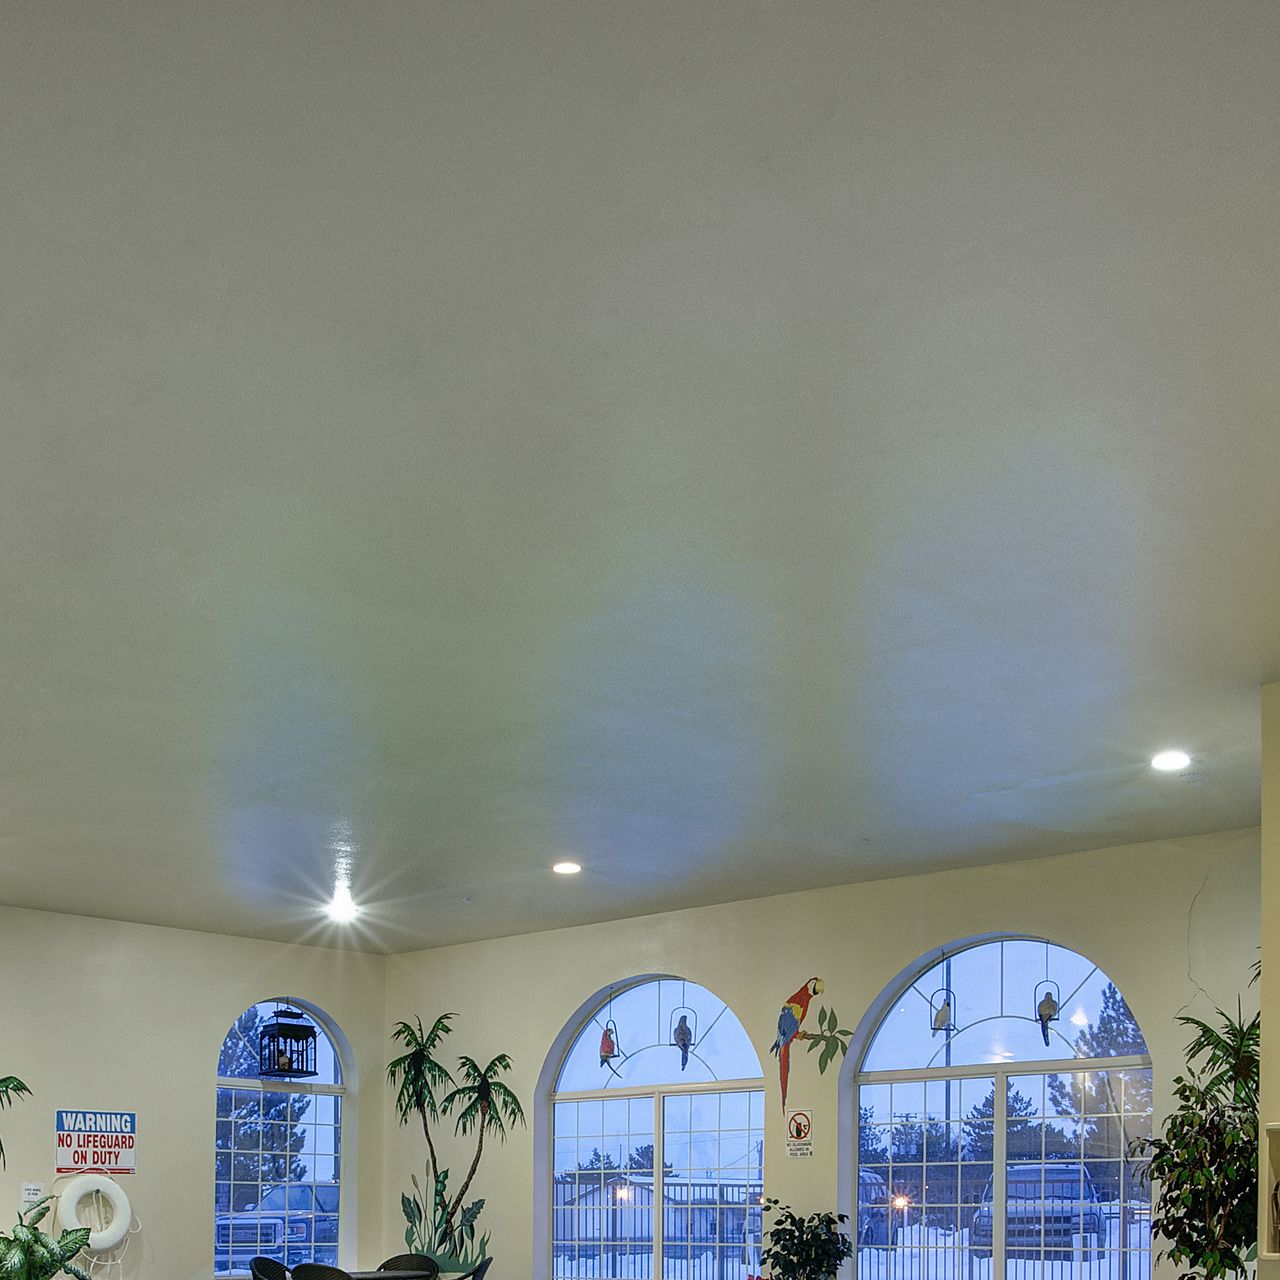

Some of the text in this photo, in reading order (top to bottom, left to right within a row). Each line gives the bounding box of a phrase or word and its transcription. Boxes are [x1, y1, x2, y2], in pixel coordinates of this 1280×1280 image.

[61, 1112, 131, 1132] WARNING
[58, 1133, 134, 1149] NO LIFEGUARD
[72, 1150, 120, 1165] ON DUTY
